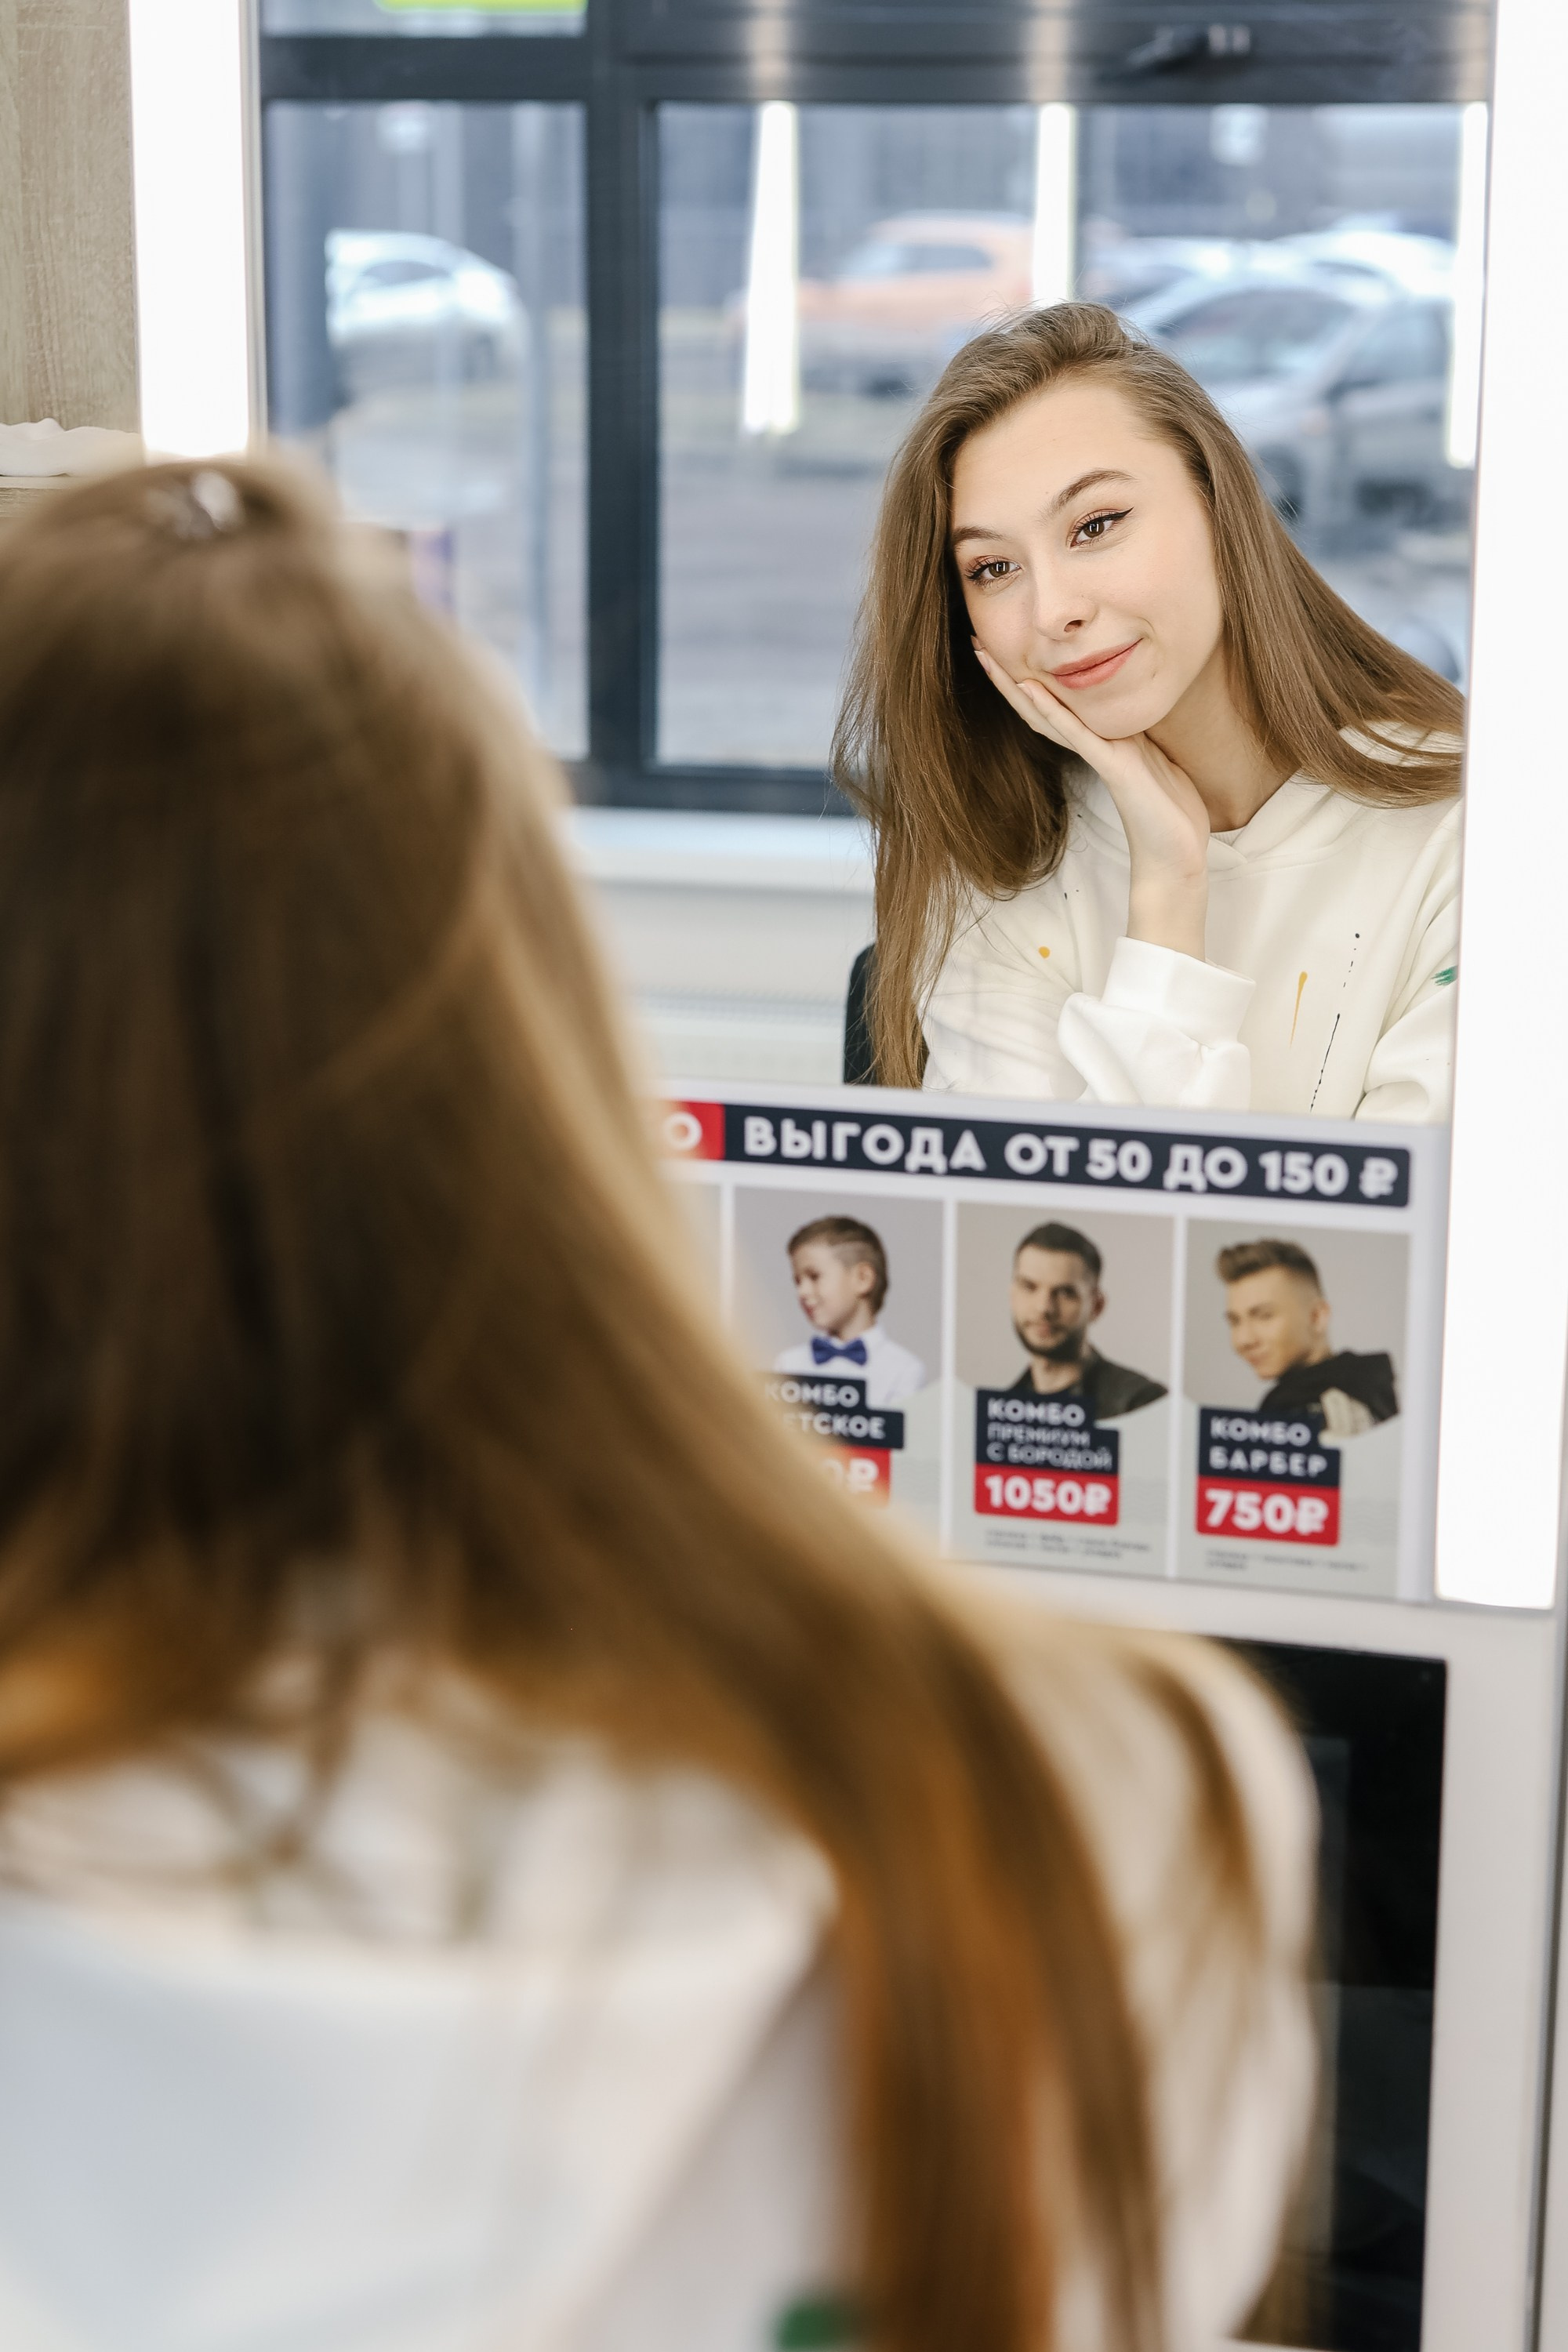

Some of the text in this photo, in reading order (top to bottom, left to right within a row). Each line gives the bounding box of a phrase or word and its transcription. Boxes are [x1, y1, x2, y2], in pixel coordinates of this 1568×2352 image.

[743, 1116, 985, 1173] ВЫГОДА
[1004, 1132, 1079, 1177] ОТ
[1085, 1139, 1152, 1182] 50
[1163, 1143, 1247, 1192] ДО
[1259, 1151, 1348, 1196] 150
[987, 1398, 1086, 1427] КОМБО
[1210, 1417, 1312, 1446] КОМБО
[1007, 1446, 1112, 1471] БОРОДОЙ
[1209, 1446, 1327, 1477] БАРБЕР
